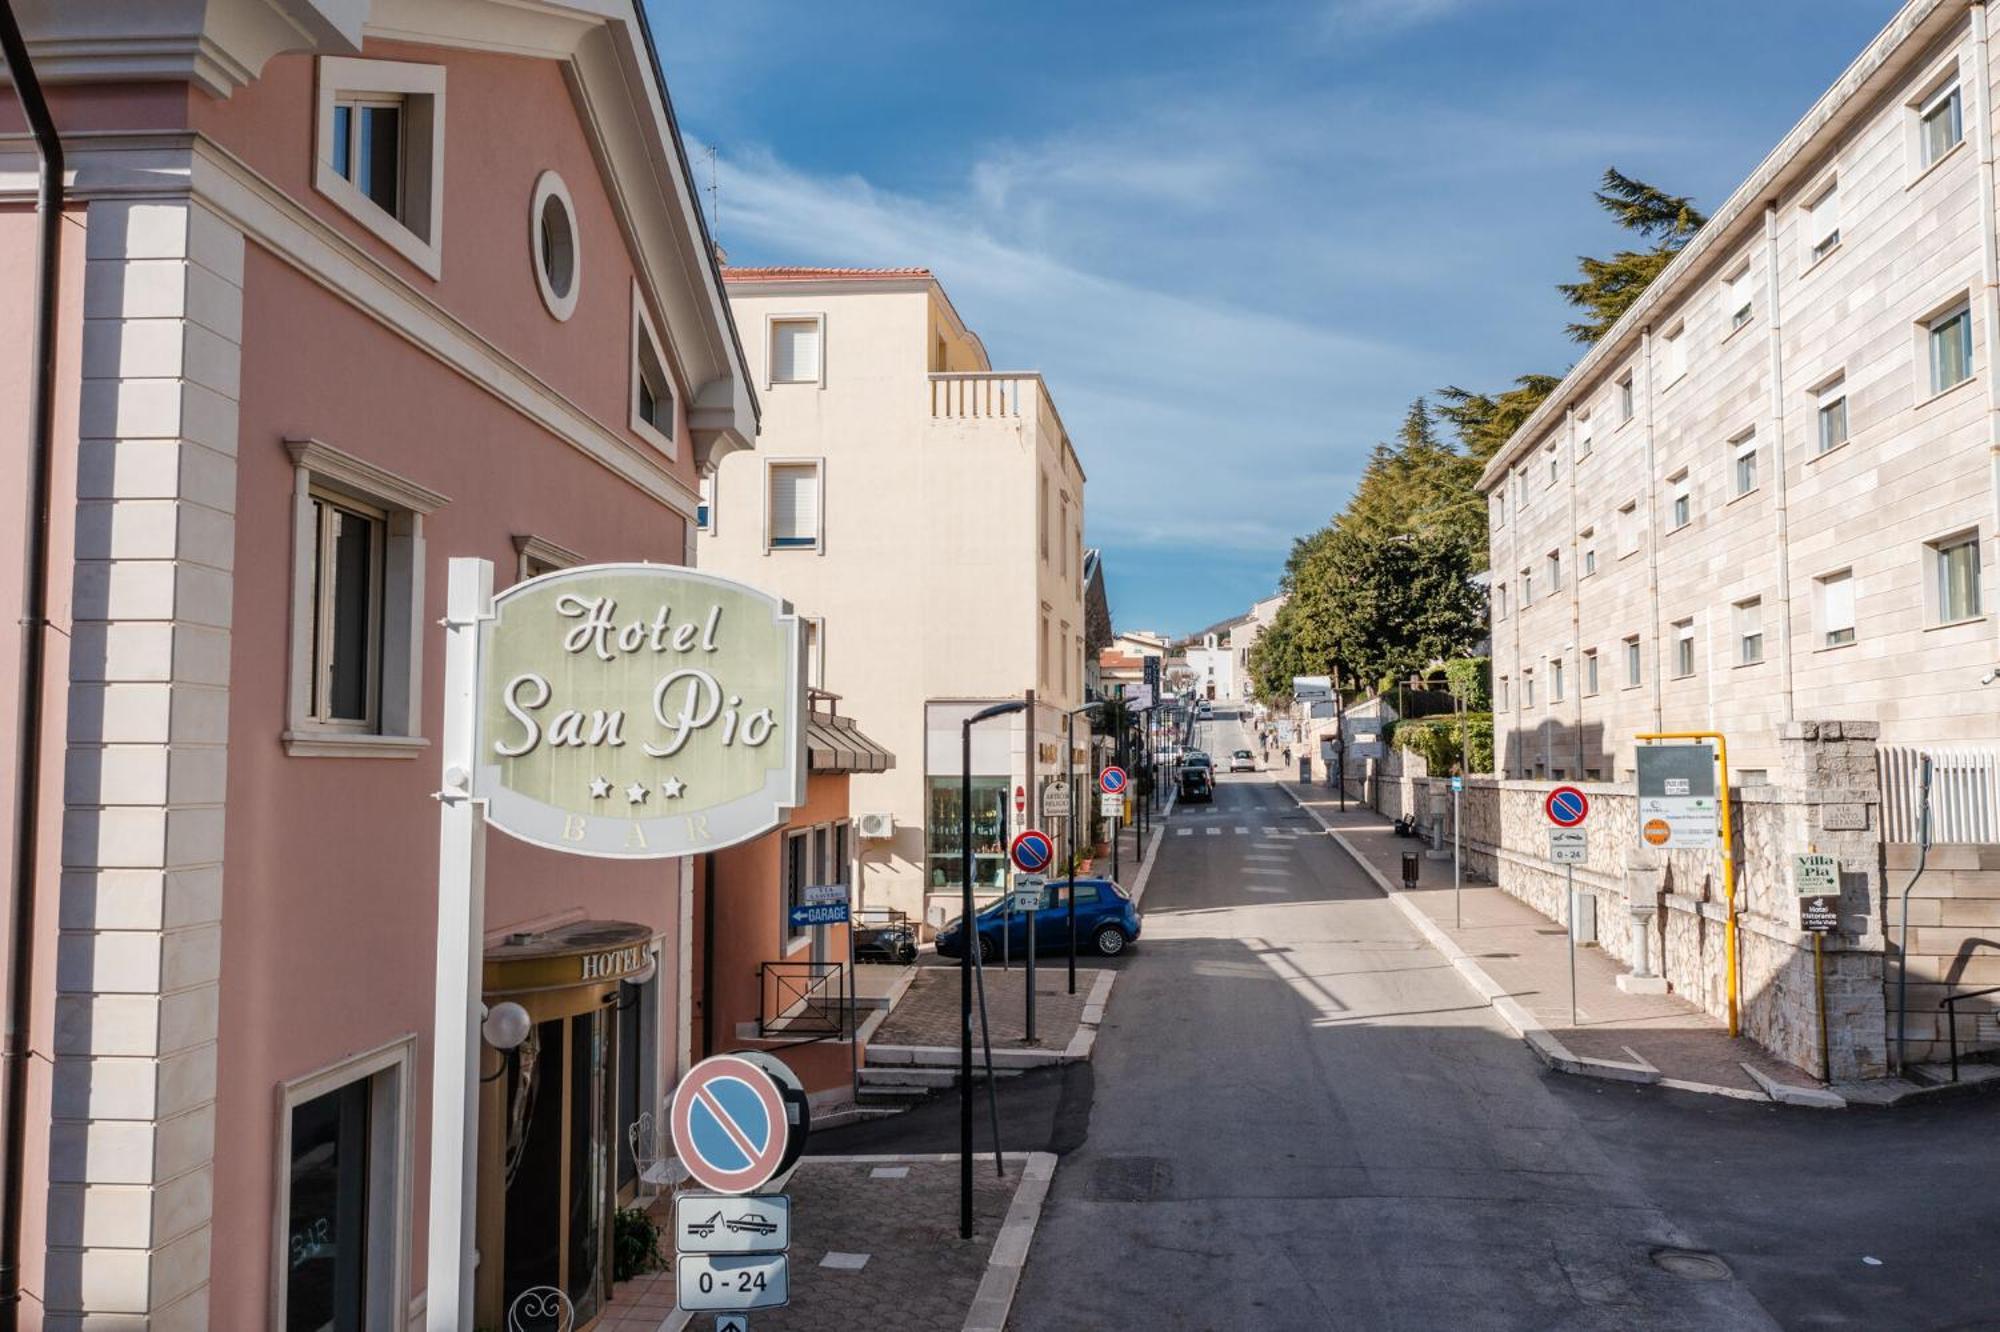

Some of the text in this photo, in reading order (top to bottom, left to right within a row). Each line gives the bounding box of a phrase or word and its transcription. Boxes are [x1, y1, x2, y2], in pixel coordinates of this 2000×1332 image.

[556, 593, 722, 661] Hotel
[494, 668, 778, 757] San Pio
[560, 814, 710, 849] BAR
[1798, 856, 1834, 866] Villa
[1805, 867, 1830, 876] Pia
[808, 906, 847, 922] GARAGE
[582, 946, 641, 980] HOTEL
[699, 1272, 713, 1293] 0
[738, 1271, 767, 1293] 24
